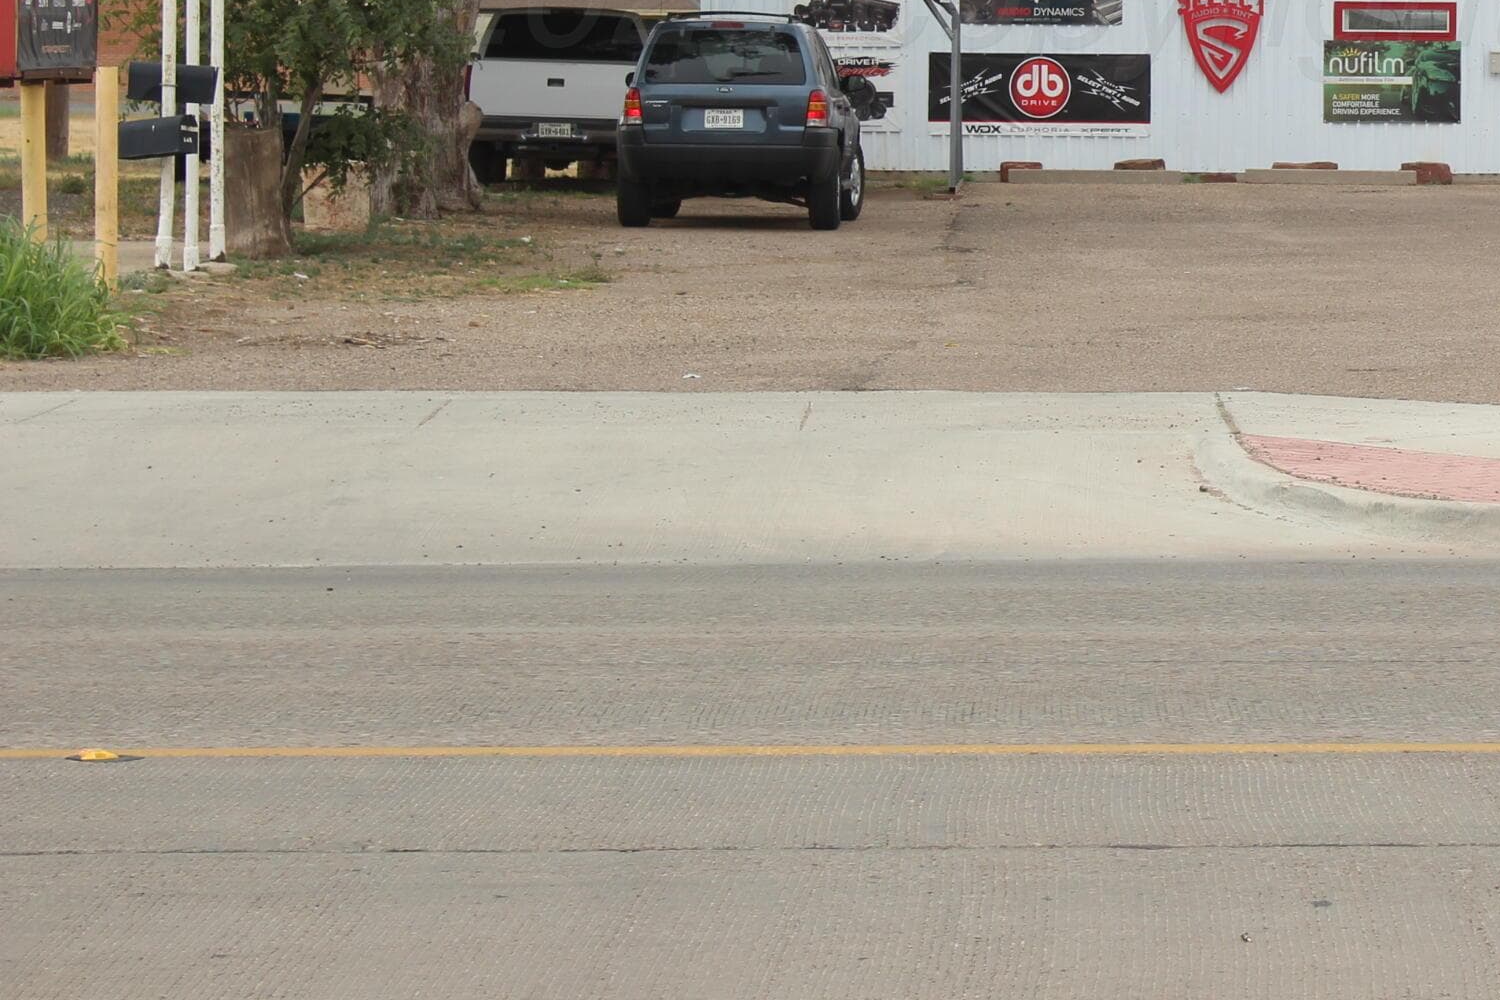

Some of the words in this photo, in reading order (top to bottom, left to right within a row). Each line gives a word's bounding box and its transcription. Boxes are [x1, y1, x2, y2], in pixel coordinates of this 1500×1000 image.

[1033, 7, 1085, 17] DYNAMICS
[1192, 7, 1220, 19] AUDIO
[1231, 8, 1254, 19] TINT
[837, 58, 870, 66] DRIVE
[1329, 51, 1404, 75] nufilm
[1016, 64, 1064, 98] db
[1077, 74, 1102, 89] SELECT
[1339, 93, 1360, 101] SAFER
[1361, 93, 1380, 101] MORE
[1332, 100, 1380, 108] COMFORTABLE
[1332, 108, 1359, 116] DRIVING
[965, 124, 1001, 134] WDX
